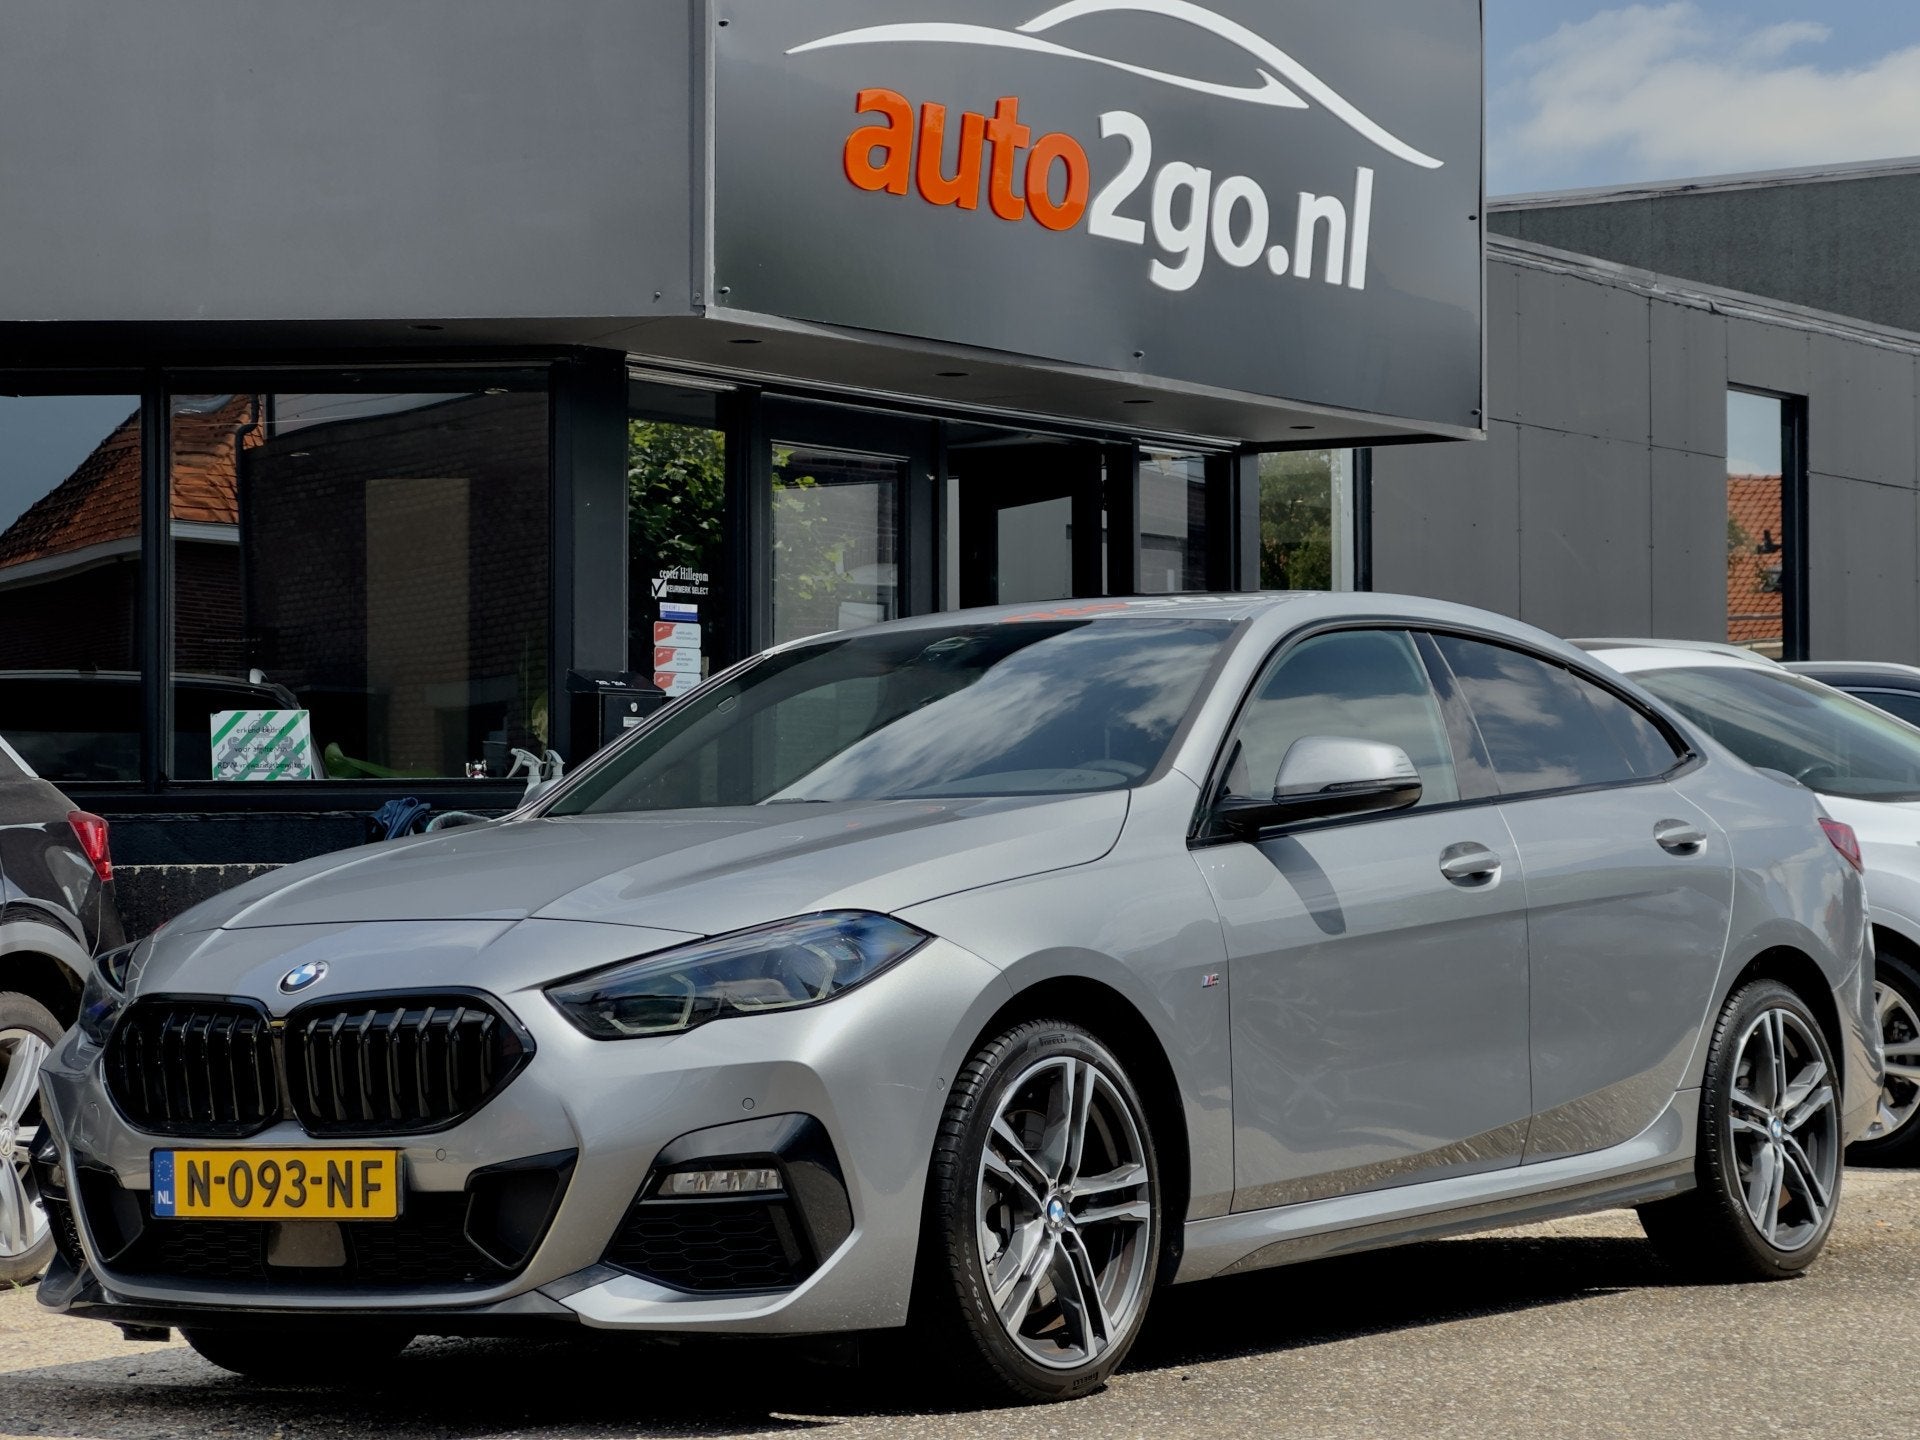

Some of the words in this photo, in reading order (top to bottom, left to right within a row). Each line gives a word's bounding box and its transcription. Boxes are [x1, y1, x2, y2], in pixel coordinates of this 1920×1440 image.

[844, 87, 1374, 292] auto2go.nl
[680, 566, 709, 586] Hillegom
[691, 586, 709, 595] SELECT
[187, 1159, 383, 1208] N-093-NF
[157, 1190, 173, 1205] NL
